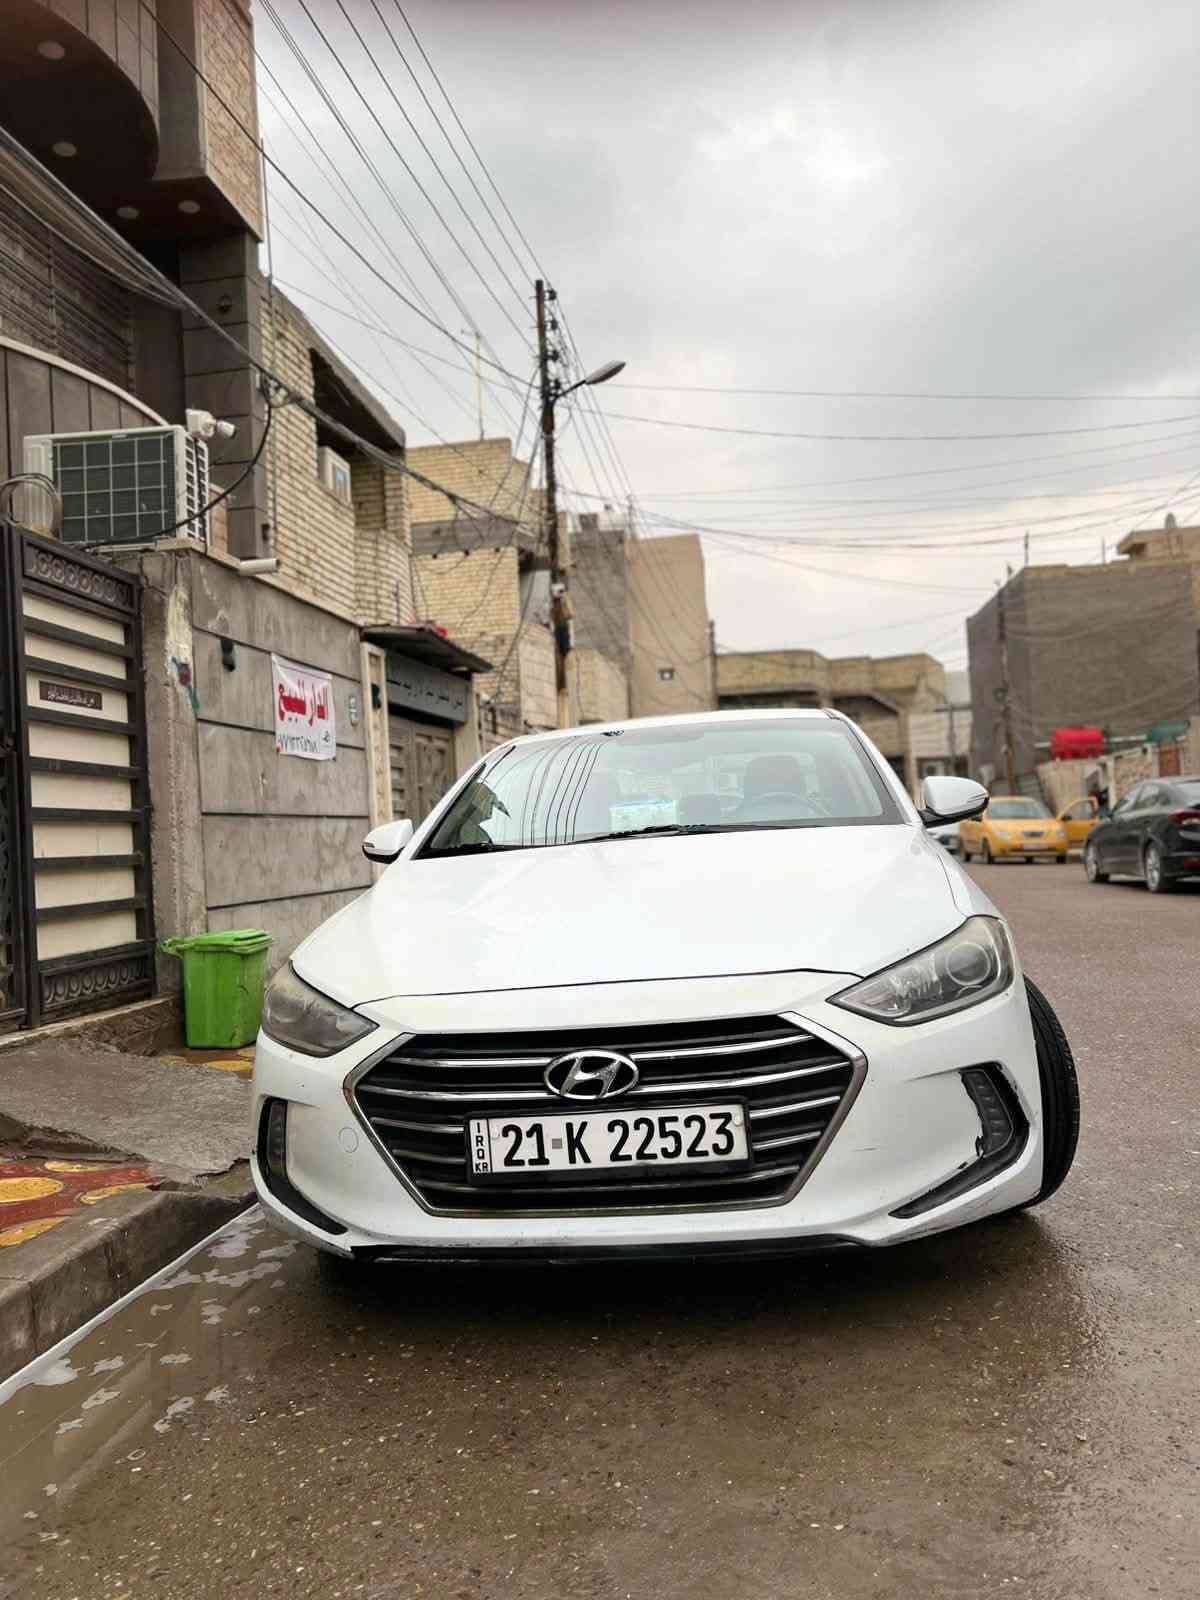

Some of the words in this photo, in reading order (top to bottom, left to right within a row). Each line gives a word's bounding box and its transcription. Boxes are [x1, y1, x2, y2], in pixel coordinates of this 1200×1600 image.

[278, 680, 306, 723] للبيع
[308, 683, 329, 726] الدار
[501, 1123, 550, 1168] 21
[565, 1121, 591, 1164] K
[607, 1112, 735, 1162] 22523
